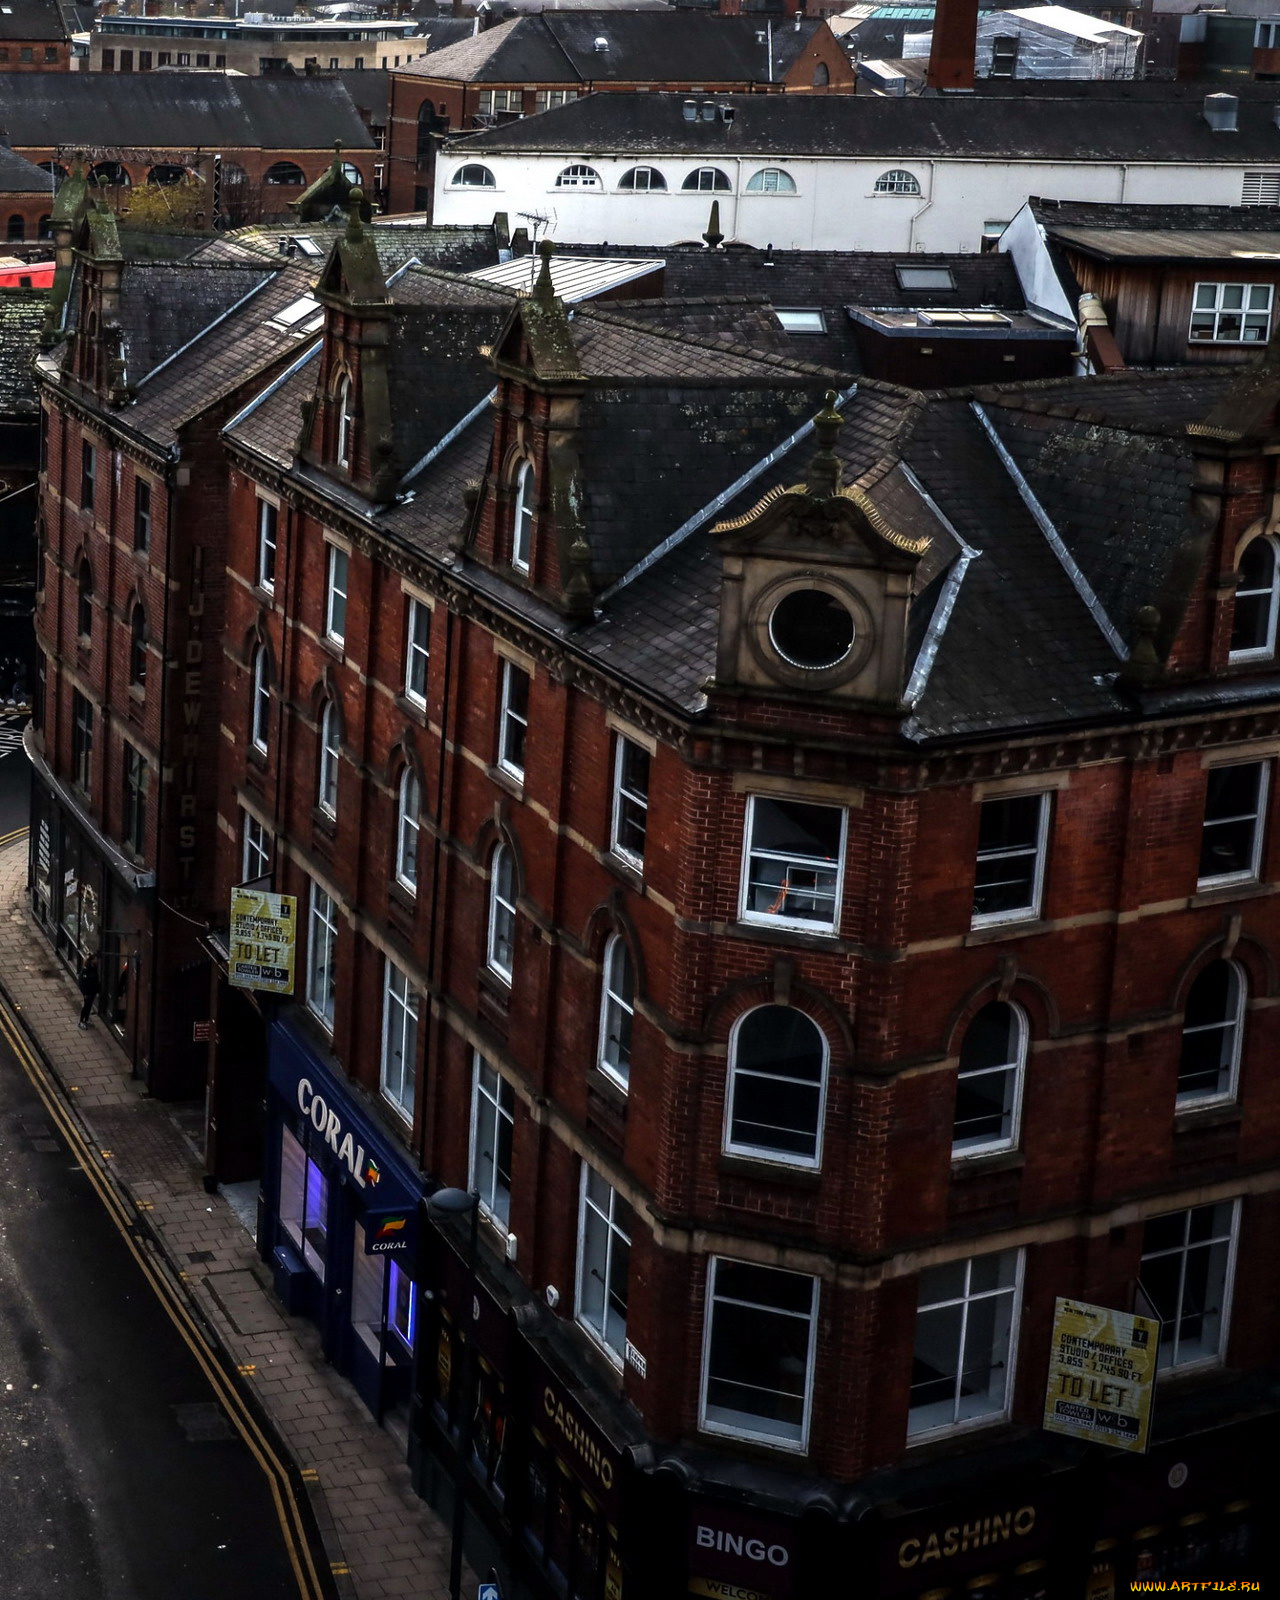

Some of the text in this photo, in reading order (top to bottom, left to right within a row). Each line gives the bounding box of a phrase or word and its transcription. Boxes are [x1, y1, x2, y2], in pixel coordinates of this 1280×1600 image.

[235, 942, 280, 963] TO LET
[297, 1078, 366, 1189] CORAL
[372, 1240, 407, 1251] CORAL
[1060, 1344, 1089, 1359] STUDIO
[1098, 1353, 1133, 1370] OFFICES
[1061, 1333, 1127, 1357] CONTEMPORARY
[1131, 1371, 1143, 1383] FT
[1057, 1373, 1127, 1408] TO LET
[543, 1386, 614, 1491] CASHINO
[695, 1524, 789, 1567] BINGO
[897, 1505, 1037, 1569] CASHINO
[705, 1580, 768, 1600] WELCO
